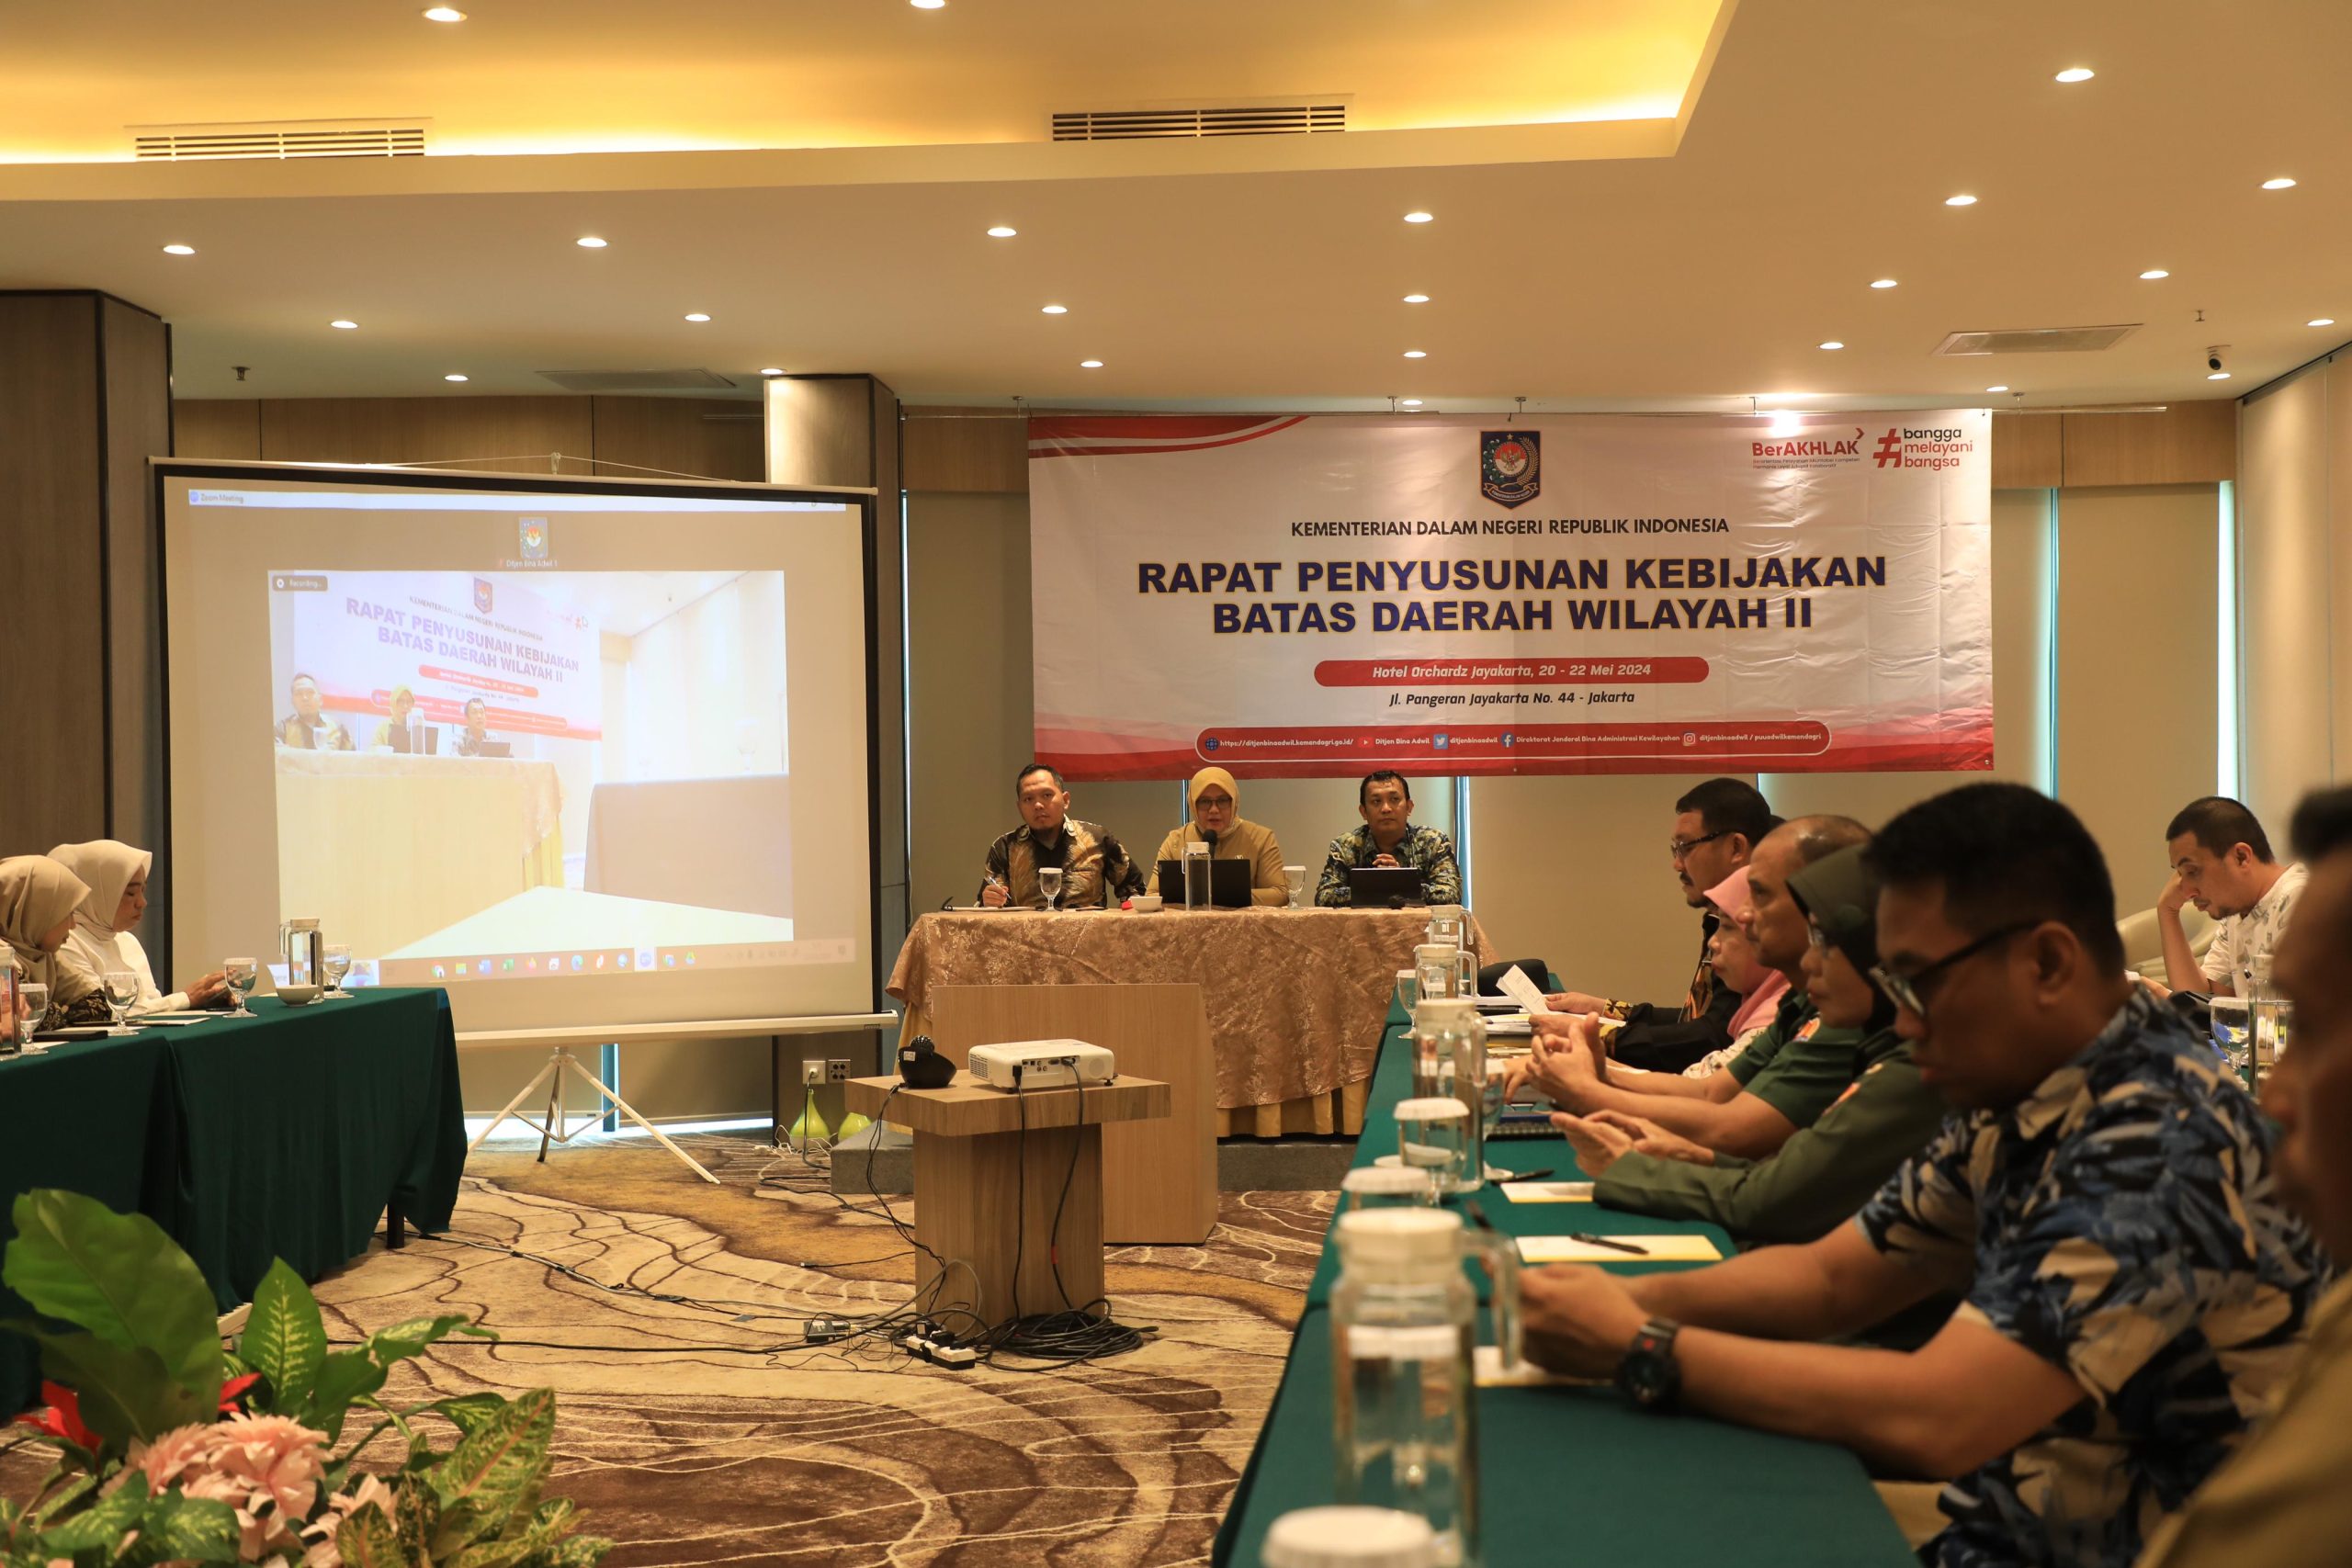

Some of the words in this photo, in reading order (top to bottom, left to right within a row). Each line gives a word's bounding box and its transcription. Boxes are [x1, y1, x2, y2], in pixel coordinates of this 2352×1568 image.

[1904, 428, 1962, 442] bangga
[1752, 440, 1859, 457] BerAKHLAK
[1905, 440, 1973, 457] melayani
[1904, 456, 1960, 471] bangsa
[1291, 522, 1412, 536] KEMENTERIAN
[1417, 521, 1478, 536] DALAM
[1482, 520, 1542, 535] NEGERI
[1549, 519, 1630, 534] REPUBLIK
[1634, 518, 1729, 534] INDONESIA
[1138, 562, 1282, 593] RAPAT
[1297, 558, 1609, 592] PENYUSUNAN
[1625, 556, 1886, 589] KEBIJAKAN
[1213, 601, 1357, 634] BATAS
[1372, 600, 1553, 632] DAERAH
[1566, 598, 1768, 630] WILAYAH
[1785, 597, 1812, 628] II
[345, 597, 407, 627] RAPAT
[412, 615, 513, 655] PENYUSUNAN
[516, 644, 580, 672] KEBIJAKAN
[378, 626, 435, 653] BATAS
[438, 642, 497, 670] DAERAH
[500, 657, 553, 682] WILAYAH
[555, 670, 563, 683] II
[1373, 665, 1408, 678] Hotel
[1411, 664, 1467, 678] Orchardz
[1470, 664, 1533, 680] Jayakarta,
[1539, 665, 1555, 676] 20
[1569, 664, 1586, 675] 22
[1590, 664, 1614, 675] Mei
[1617, 664, 1651, 675] 2024
[1389, 693, 1401, 706] Jl.
[1406, 693, 1465, 707] Pangeran
[1469, 692, 1529, 706] Jayakarta
[1533, 693, 1553, 704] No.
[1558, 693, 1575, 703] 44
[1588, 691, 1634, 705] Jakarta
[1450, 737, 1498, 745] ditjenbinaadwil
[1638, 735, 1680, 743] Kewilayahan
[1700, 733, 1748, 741] ditjenbinaadwil
